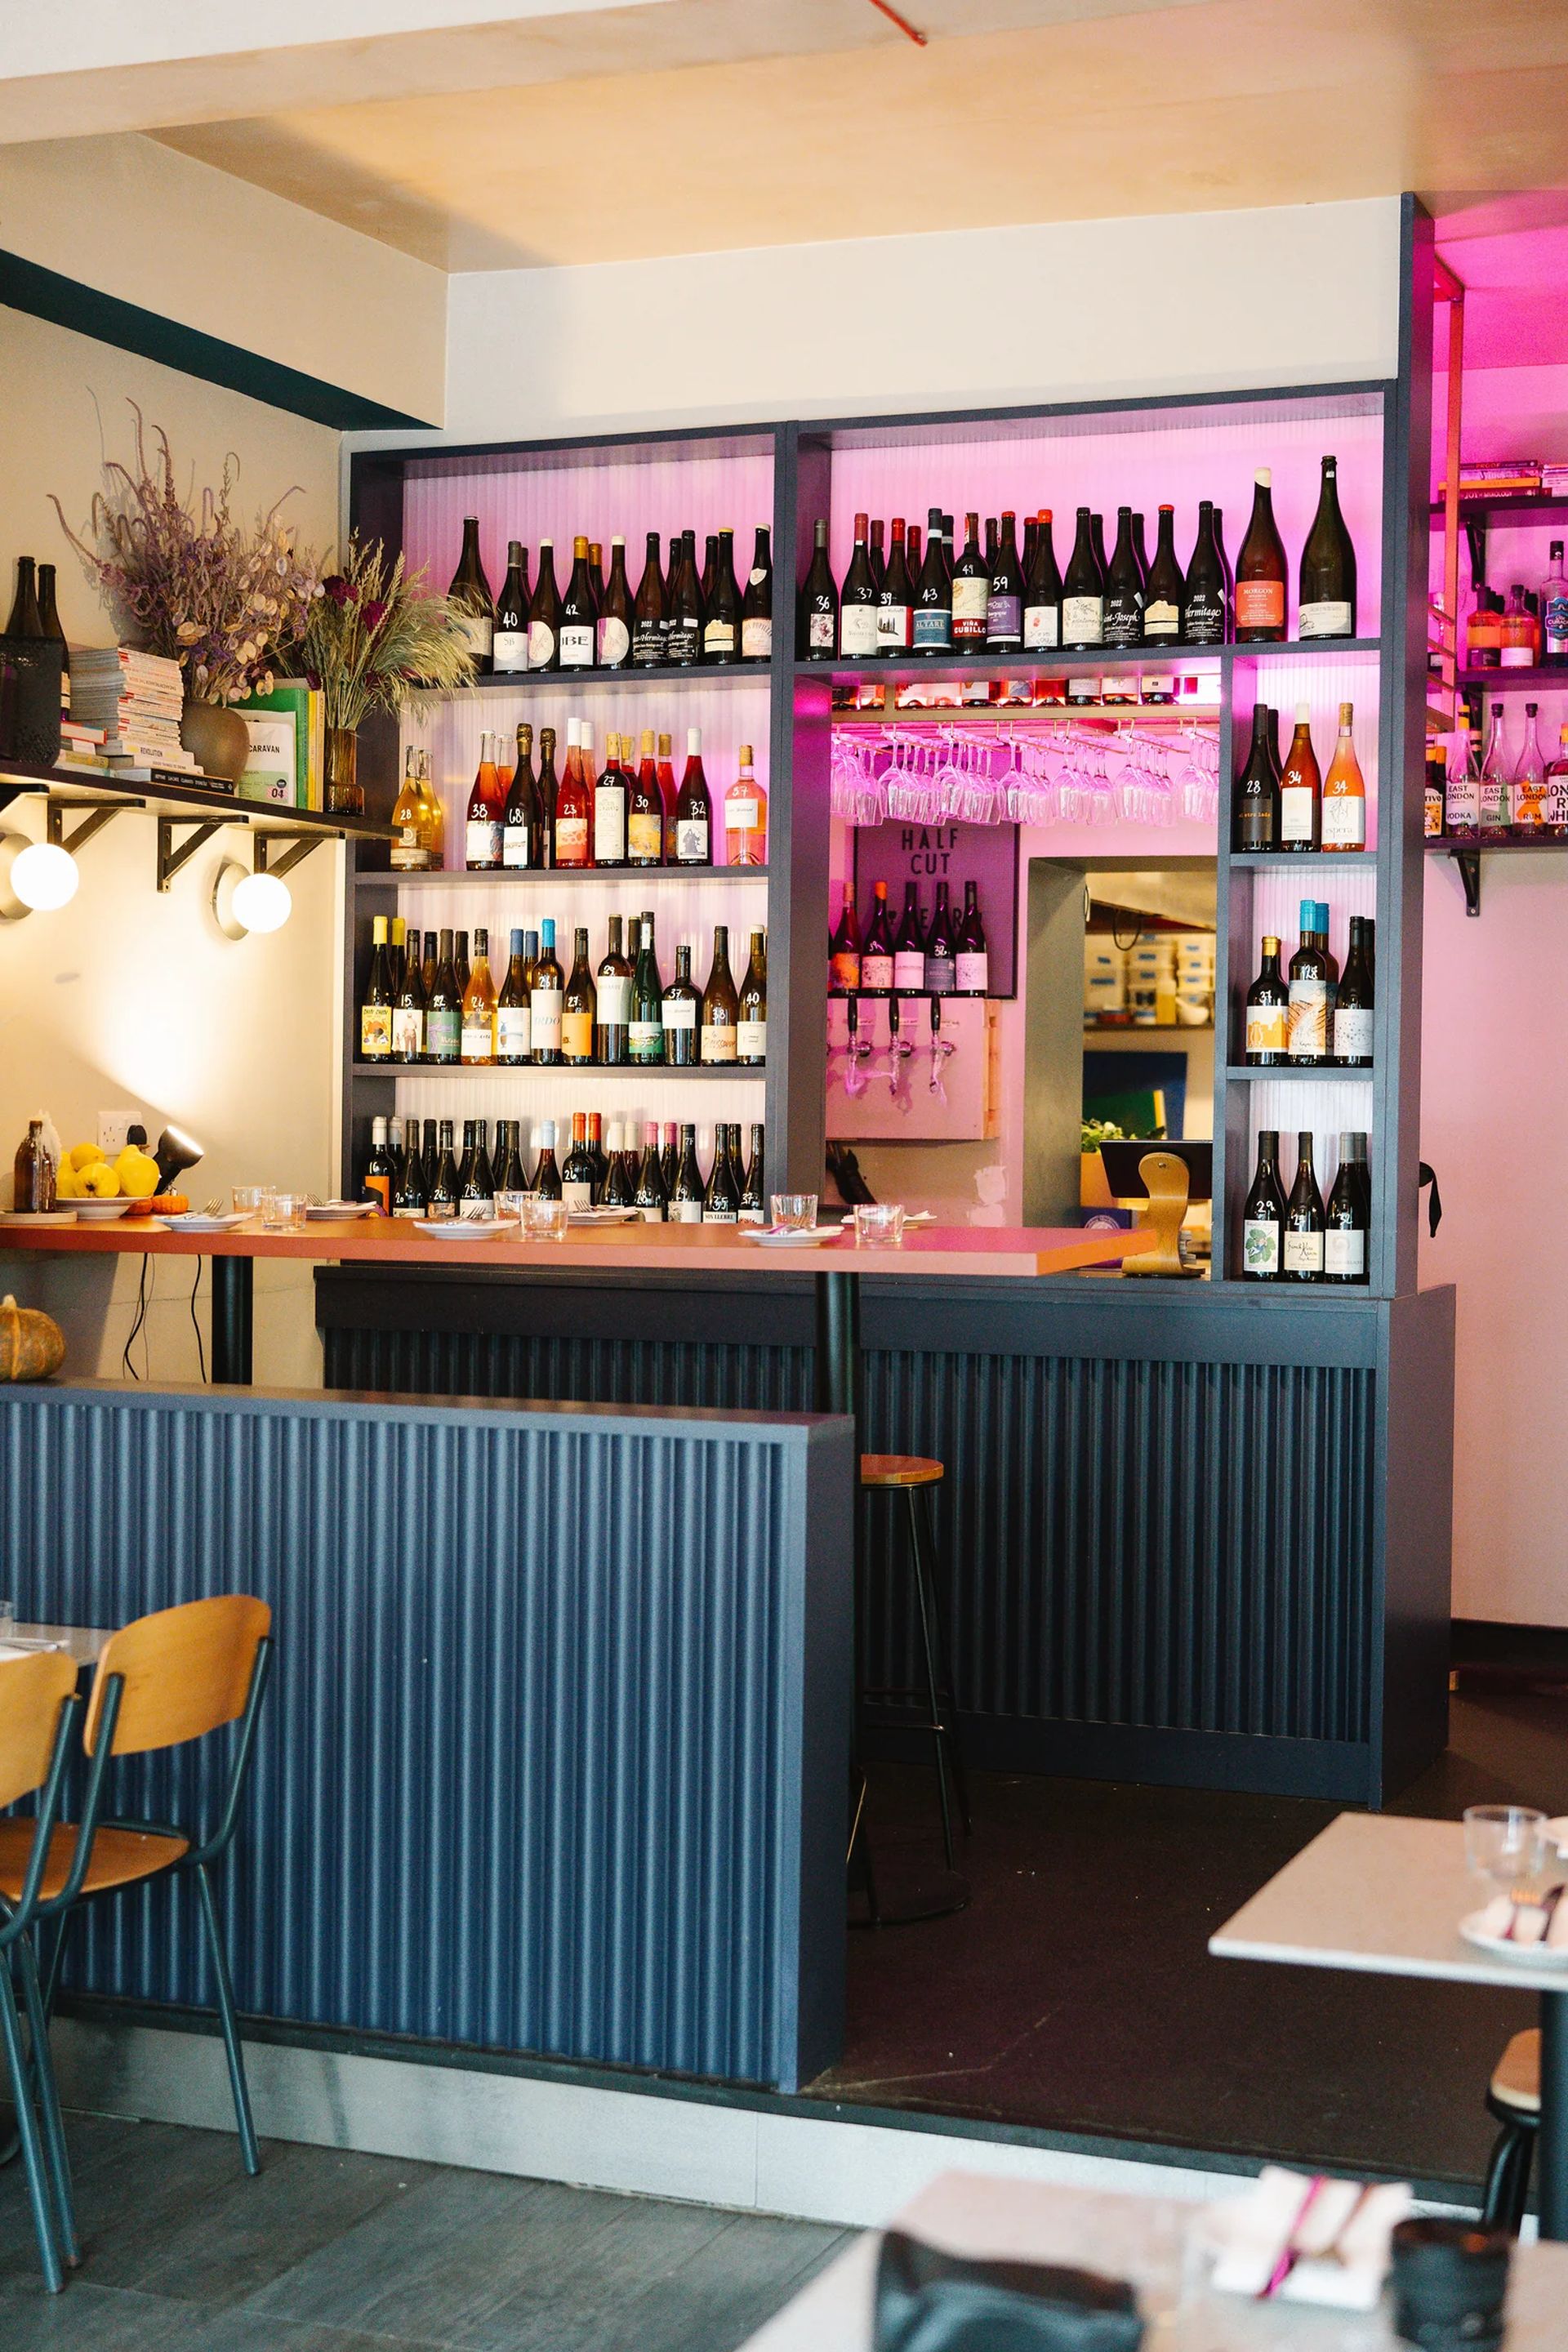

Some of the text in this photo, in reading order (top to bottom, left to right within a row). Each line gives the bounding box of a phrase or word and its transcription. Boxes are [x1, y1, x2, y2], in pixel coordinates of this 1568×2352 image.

[992, 576, 1008, 591] 59
[858, 587, 872, 600] 37
[880, 593, 892, 605] 39
[921, 588, 938, 602] 43
[565, 604, 579, 616] 42
[817, 595, 830, 612] 36
[503, 612, 518, 628] 40
[954, 625, 986, 634] CUBILLO
[603, 775, 614, 786] 27
[1288, 770, 1302, 784] 34
[271, 788, 284, 798] 04
[1246, 780, 1261, 794] 28
[1332, 780, 1348, 795] 34
[1484, 786, 1504, 795] EAST
[635, 795, 648, 808] 30
[400, 809, 412, 821] 28
[471, 804, 488, 818] 38
[564, 804, 577, 815] 23
[901, 828, 959, 850] HALF
[911, 853, 951, 875] CUT
[401, 994, 412, 1007] 15
[746, 991, 760, 1005] 40
[369, 1160, 380, 1174] 16
[464, 1183, 477, 1198] 25
